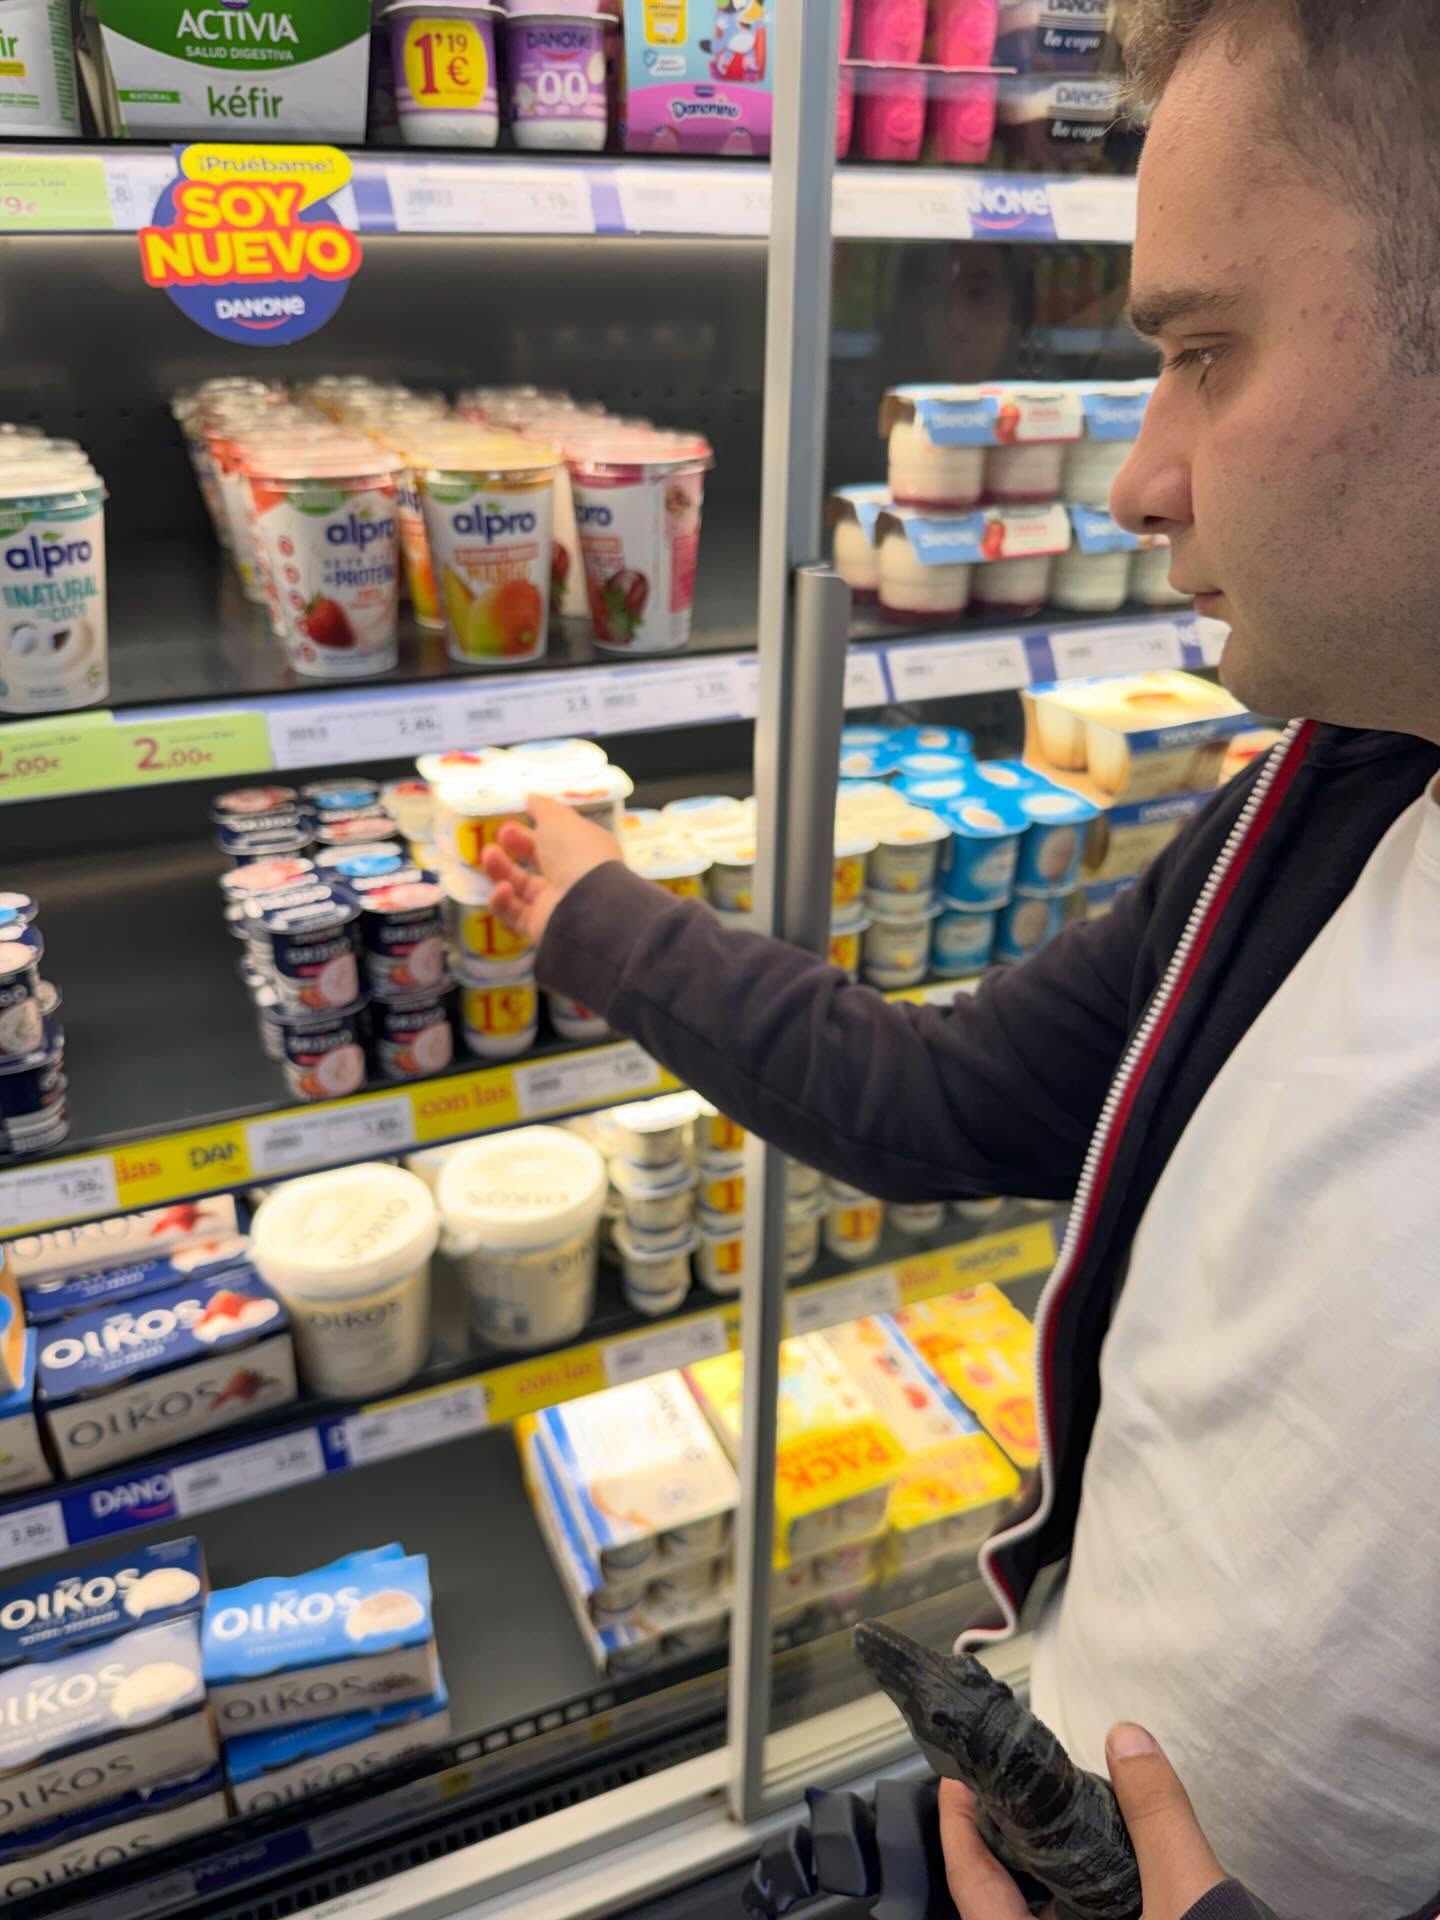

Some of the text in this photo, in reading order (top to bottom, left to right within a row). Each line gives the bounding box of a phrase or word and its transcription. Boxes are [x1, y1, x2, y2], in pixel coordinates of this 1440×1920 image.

[176, 9, 300, 43] ACTIVIA
[185, 45, 294, 61] SALUD DIGESTIVA
[207, 86, 283, 119] kéfir
[181, 186, 300, 228] SOY
[144, 229, 352, 278] NUEVO
[451, 501, 537, 544] alpro
[4, 535, 92, 578] alpro
[41, 1299, 206, 1370] OIKOS
[67, 1377, 221, 1449] OIKOS
[0, 1567, 140, 1631] OIKOS
[212, 1585, 362, 1640] OIKOS
[222, 1674, 366, 1723] OIKOS
